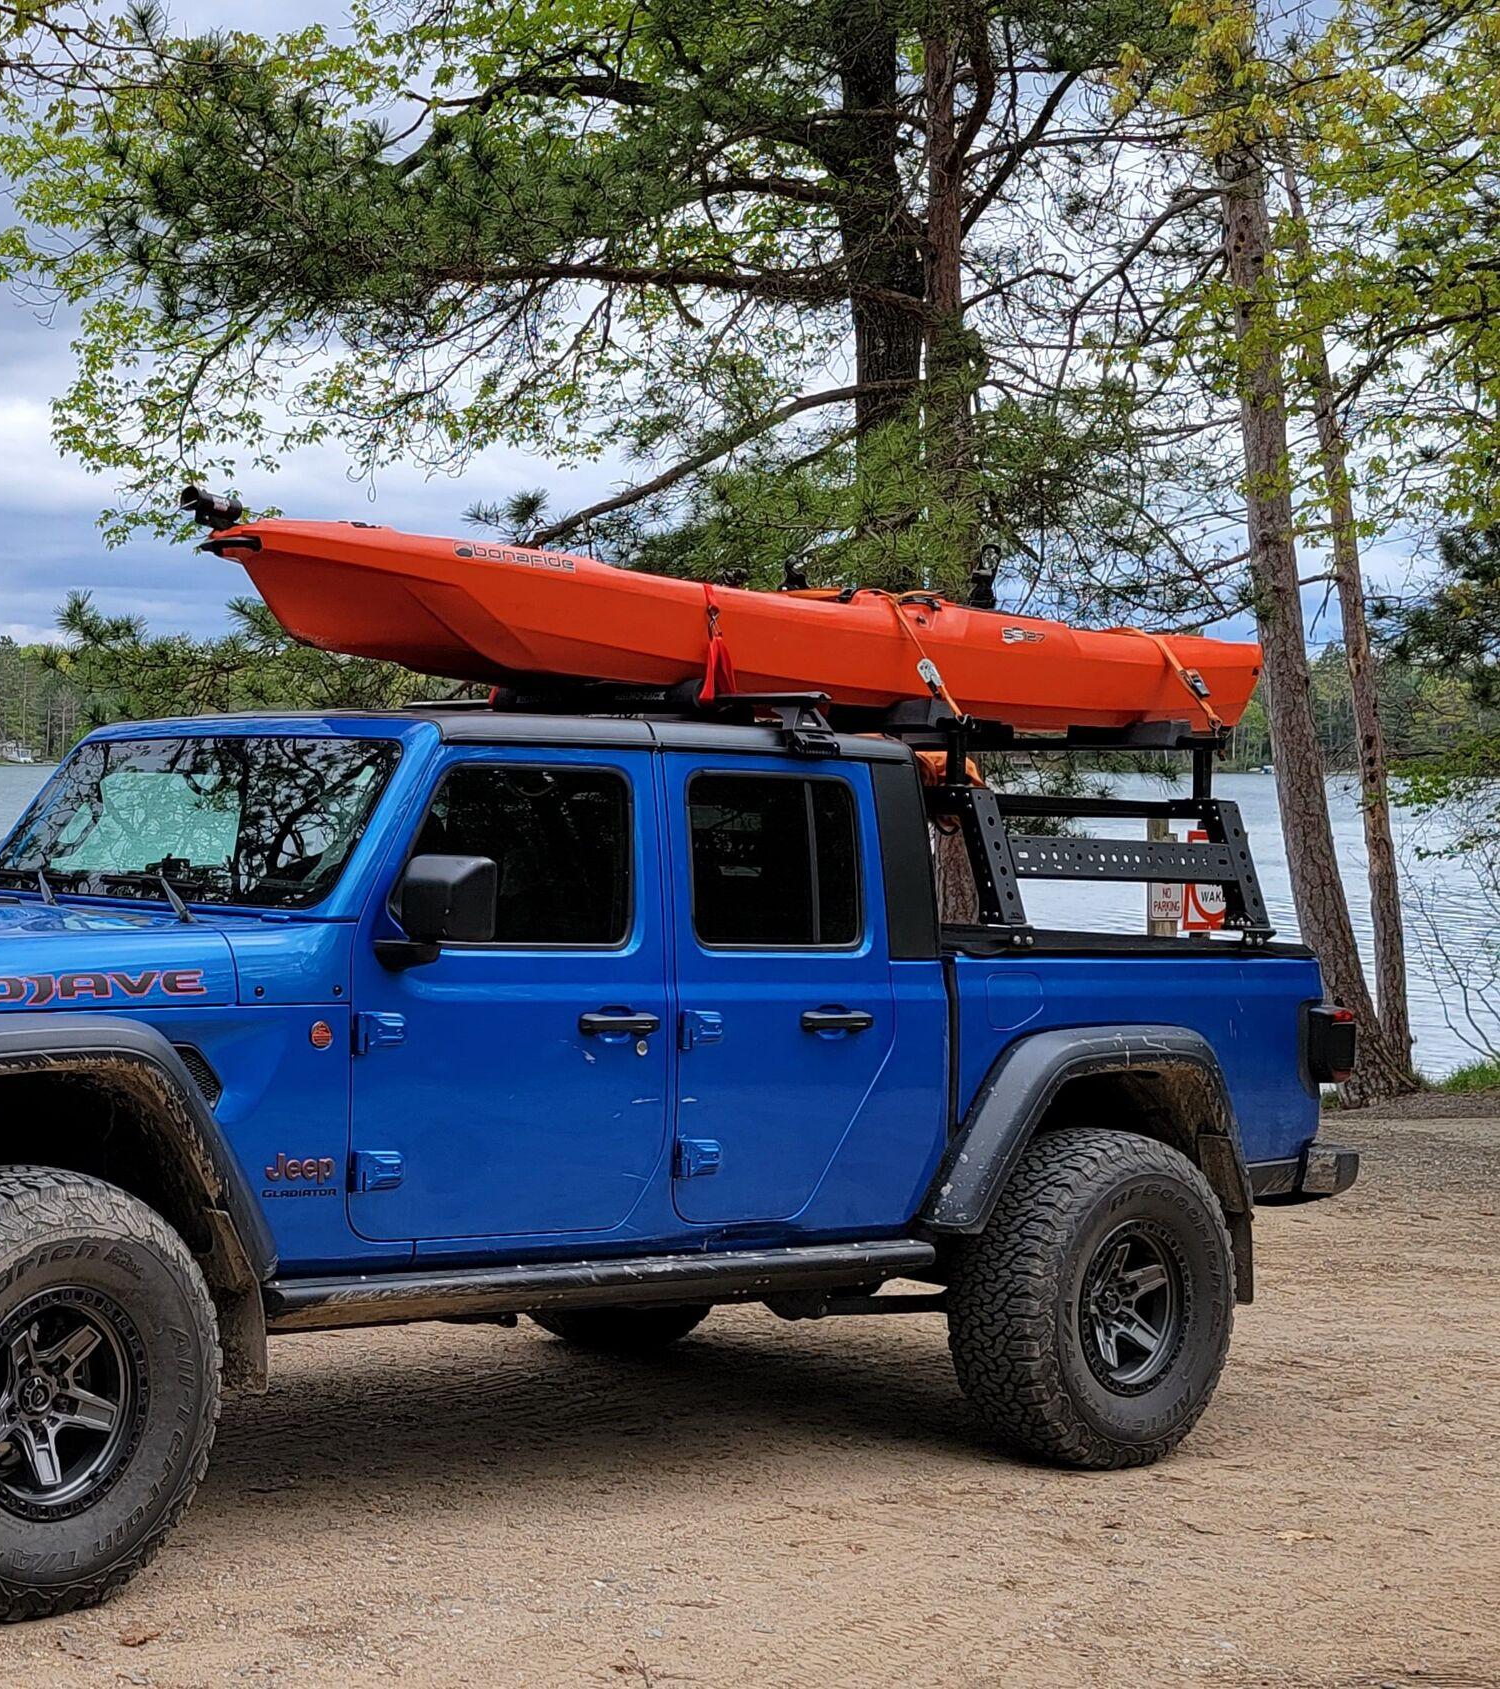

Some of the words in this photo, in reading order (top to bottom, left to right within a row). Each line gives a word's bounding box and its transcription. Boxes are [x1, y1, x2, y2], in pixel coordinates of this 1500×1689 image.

[473, 544, 575, 569] bonafide
[1003, 629, 1045, 643] SS127
[1162, 888, 1172, 899] NO
[1153, 900, 1180, 912] PARKING
[265, 1152, 335, 1184] Jeep
[261, 1188, 338, 1198] GLADIATOR
[92, 1325, 196, 1558] All-Terrain
